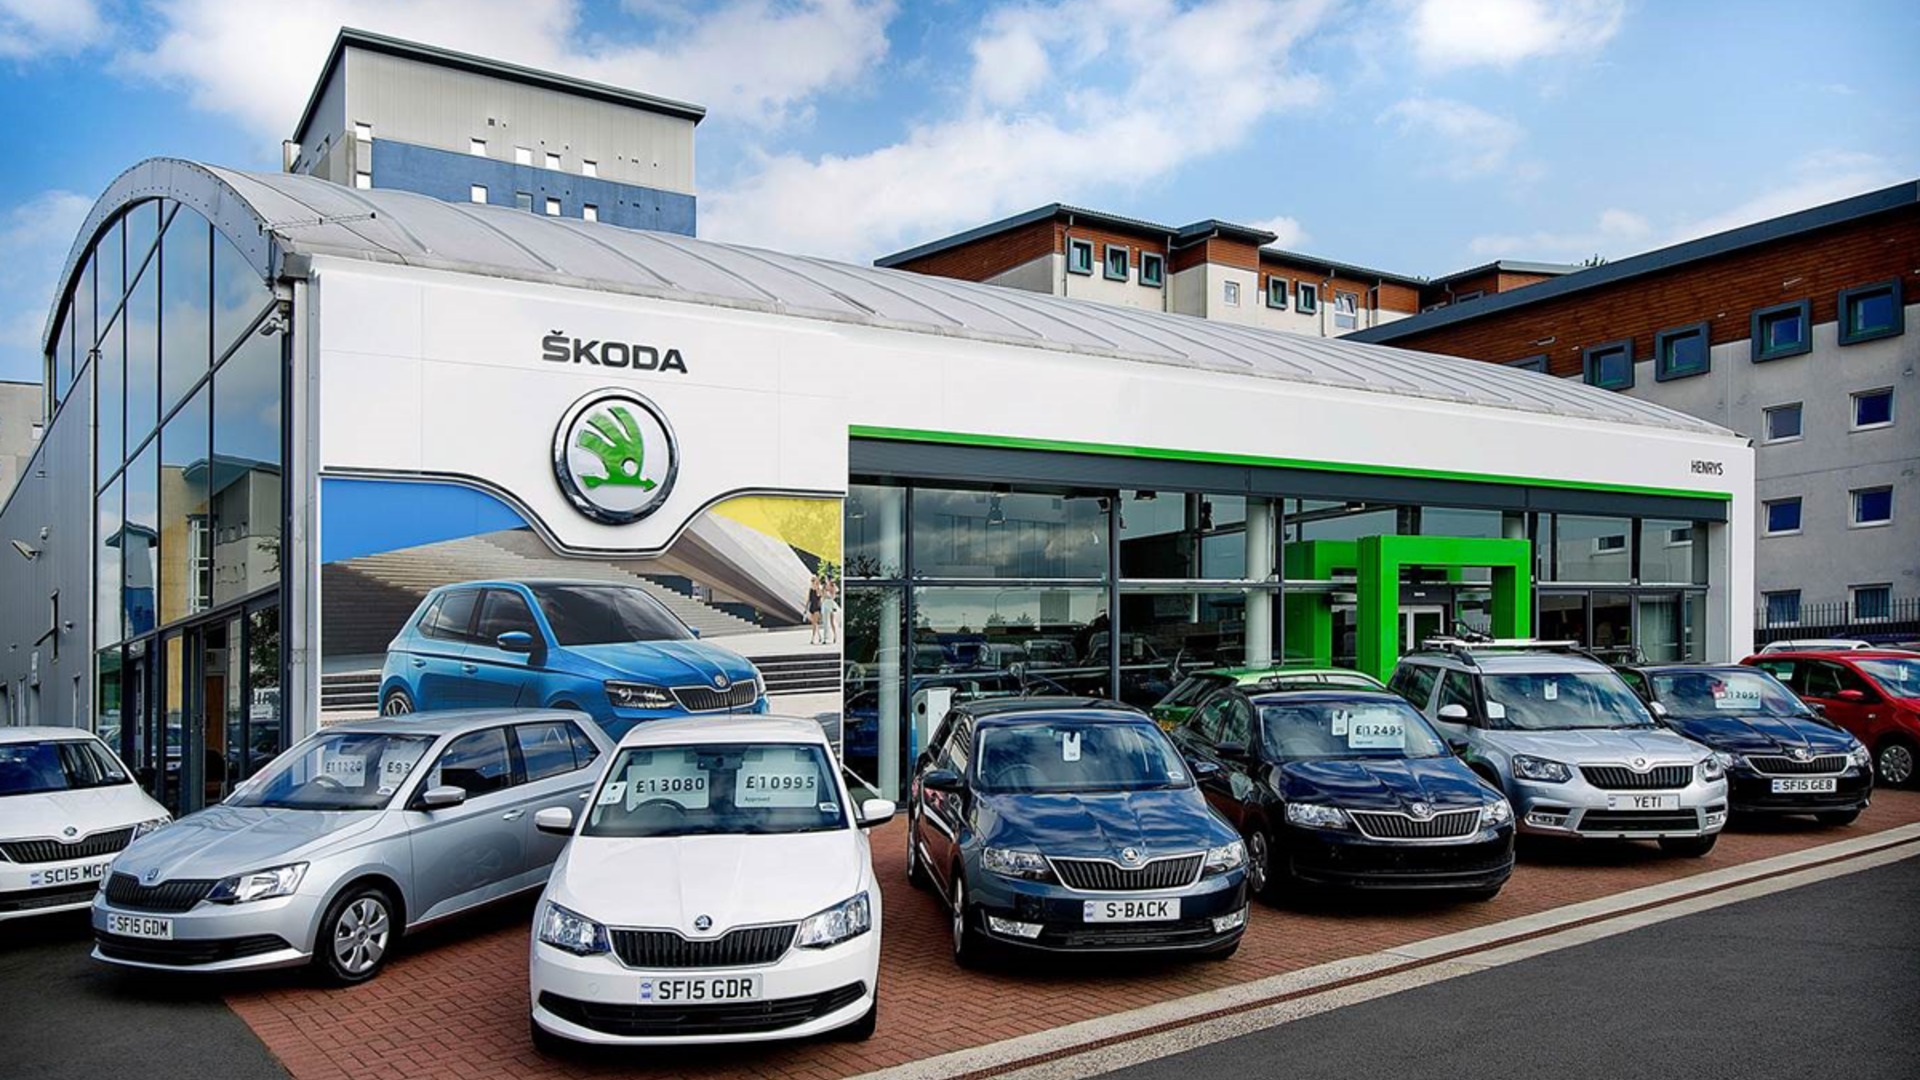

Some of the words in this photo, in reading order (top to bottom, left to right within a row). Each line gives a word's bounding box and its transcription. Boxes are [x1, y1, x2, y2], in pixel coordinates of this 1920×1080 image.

[542, 329, 688, 374] ŠKODA
[1690, 459, 1724, 476] HENRYS
[635, 776, 705, 794] £13080
[745, 775, 815, 790] £10995
[1633, 796, 1662, 808] YETI
[44, 866, 79, 884] SC15
[1106, 901, 1168, 919] S-BACK
[116, 915, 141, 934] SF15
[143, 918, 168, 937] GDM
[658, 980, 706, 1000] SF15
[711, 978, 753, 999] GDR
